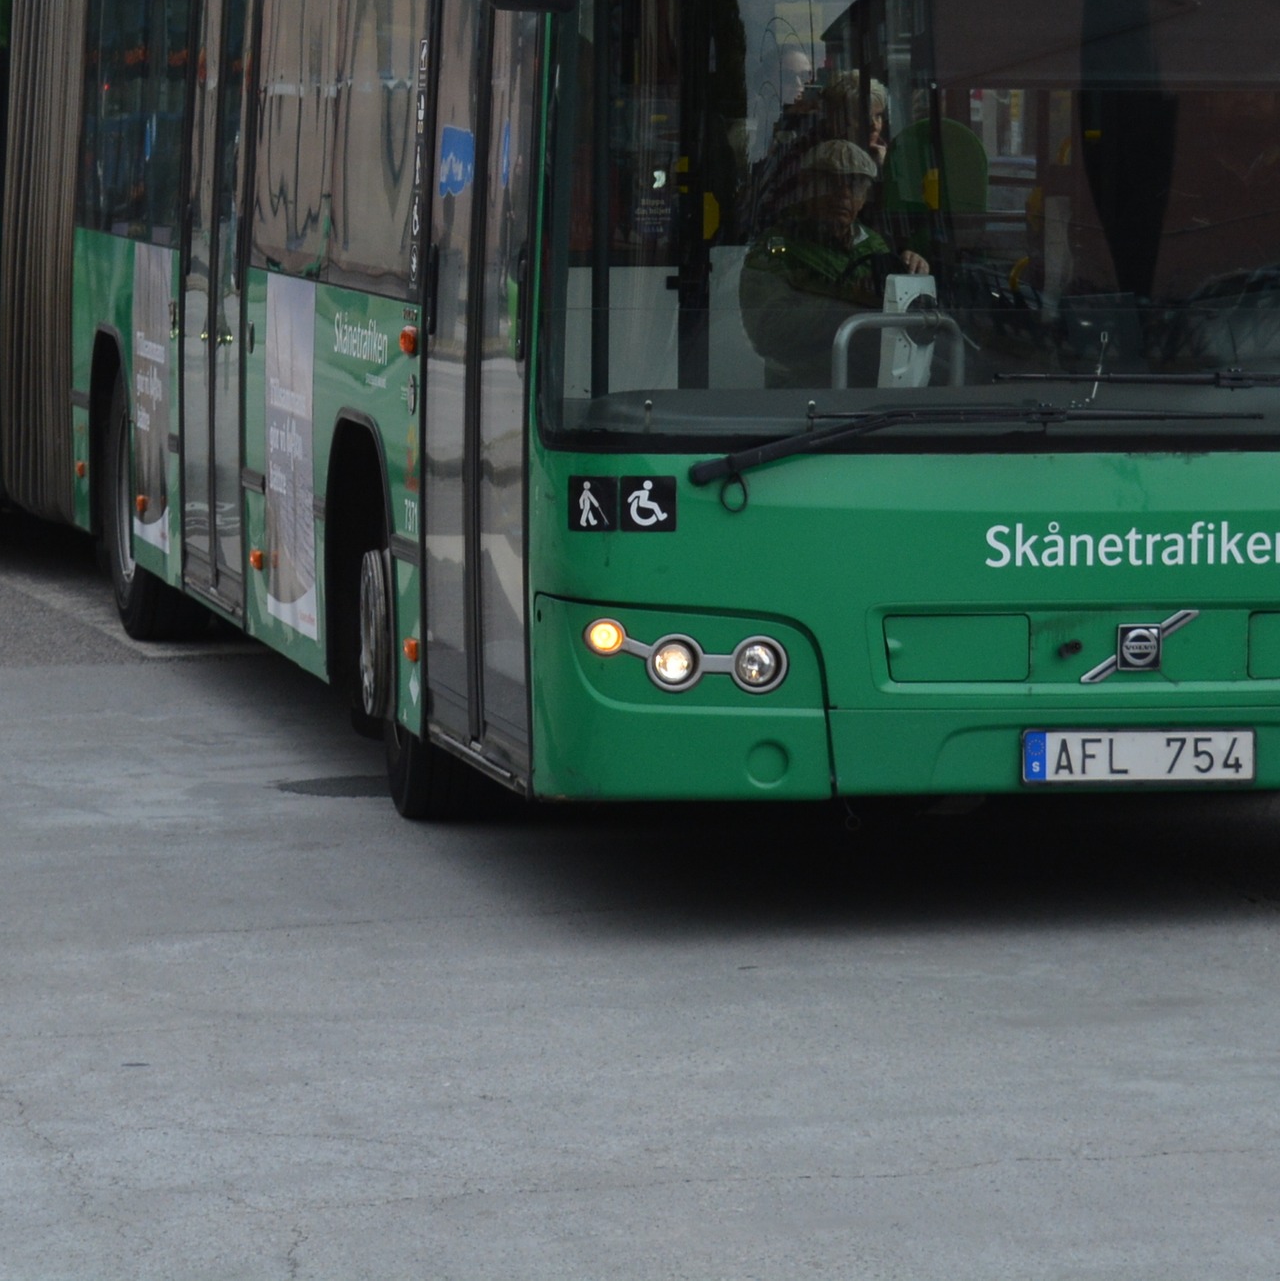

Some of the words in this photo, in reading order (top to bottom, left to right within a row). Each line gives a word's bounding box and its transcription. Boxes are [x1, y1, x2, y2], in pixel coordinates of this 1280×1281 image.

[334, 312, 388, 366] Skånetrafiken
[1123, 643, 1157, 652] VOLVO
[1032, 761, 1041, 773] S
[1054, 737, 1129, 776] AFL
[1165, 736, 1243, 775] 754
